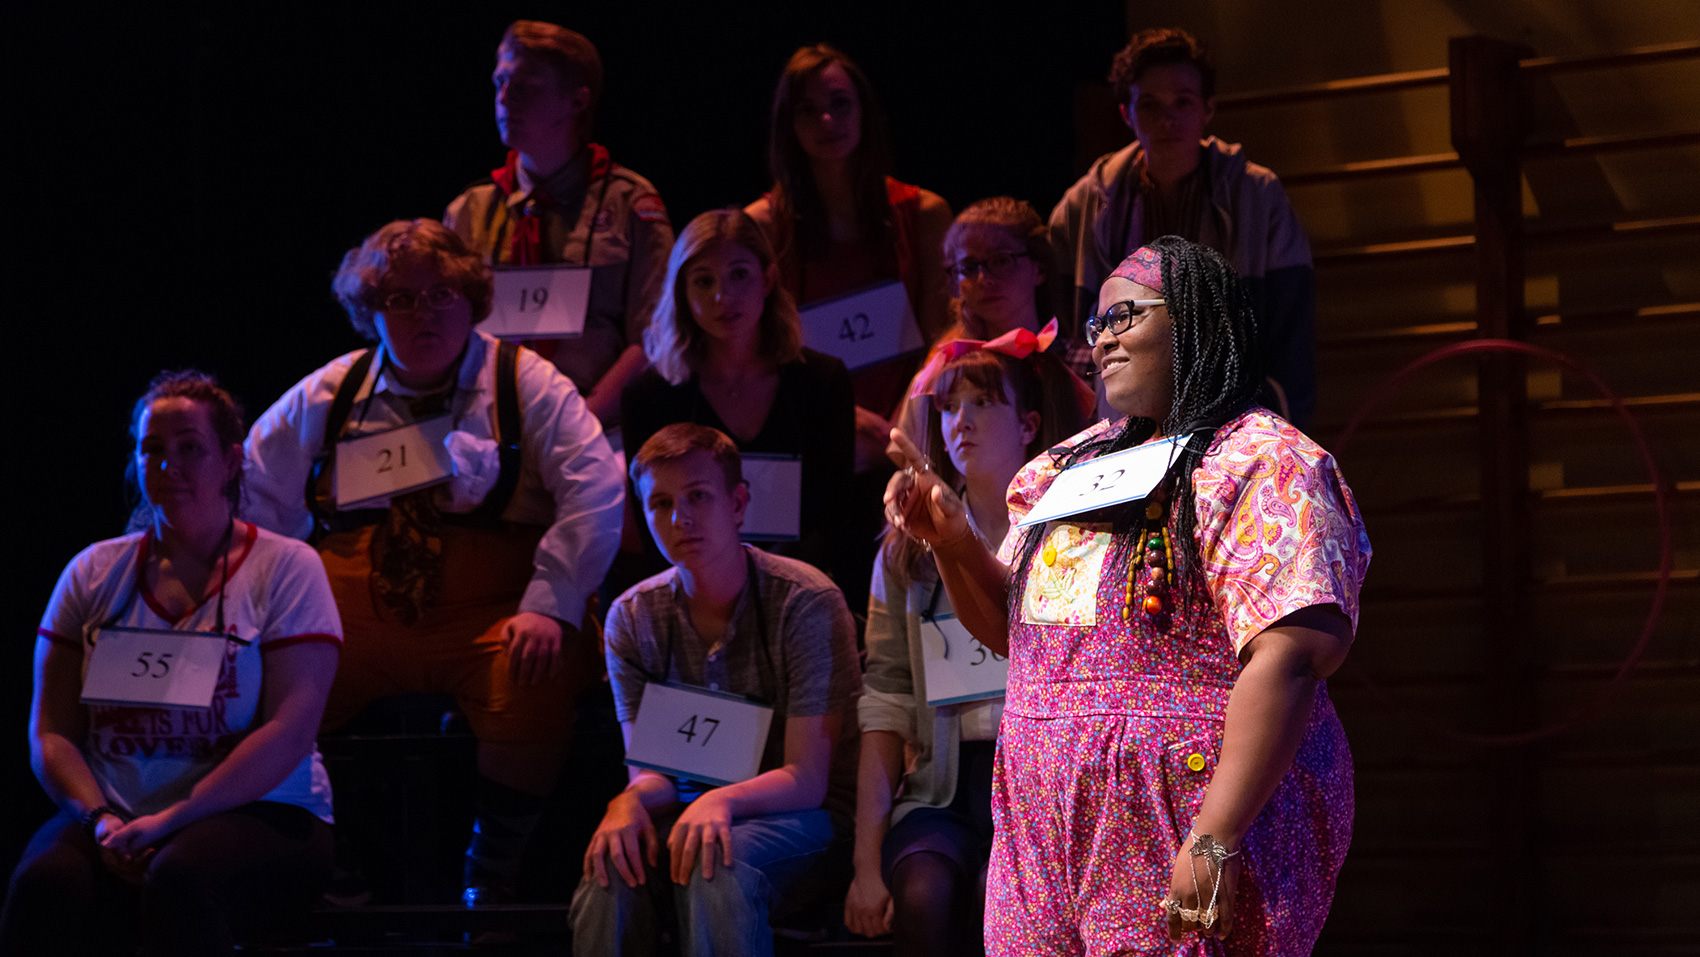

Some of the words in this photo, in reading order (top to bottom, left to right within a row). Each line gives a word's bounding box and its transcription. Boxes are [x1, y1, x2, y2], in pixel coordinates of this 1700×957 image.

[519, 287, 548, 312] 19
[839, 313, 874, 342] 42
[376, 444, 407, 474] 21
[1079, 469, 1125, 497] 32
[131, 652, 173, 678] 55
[677, 715, 720, 747] 47
